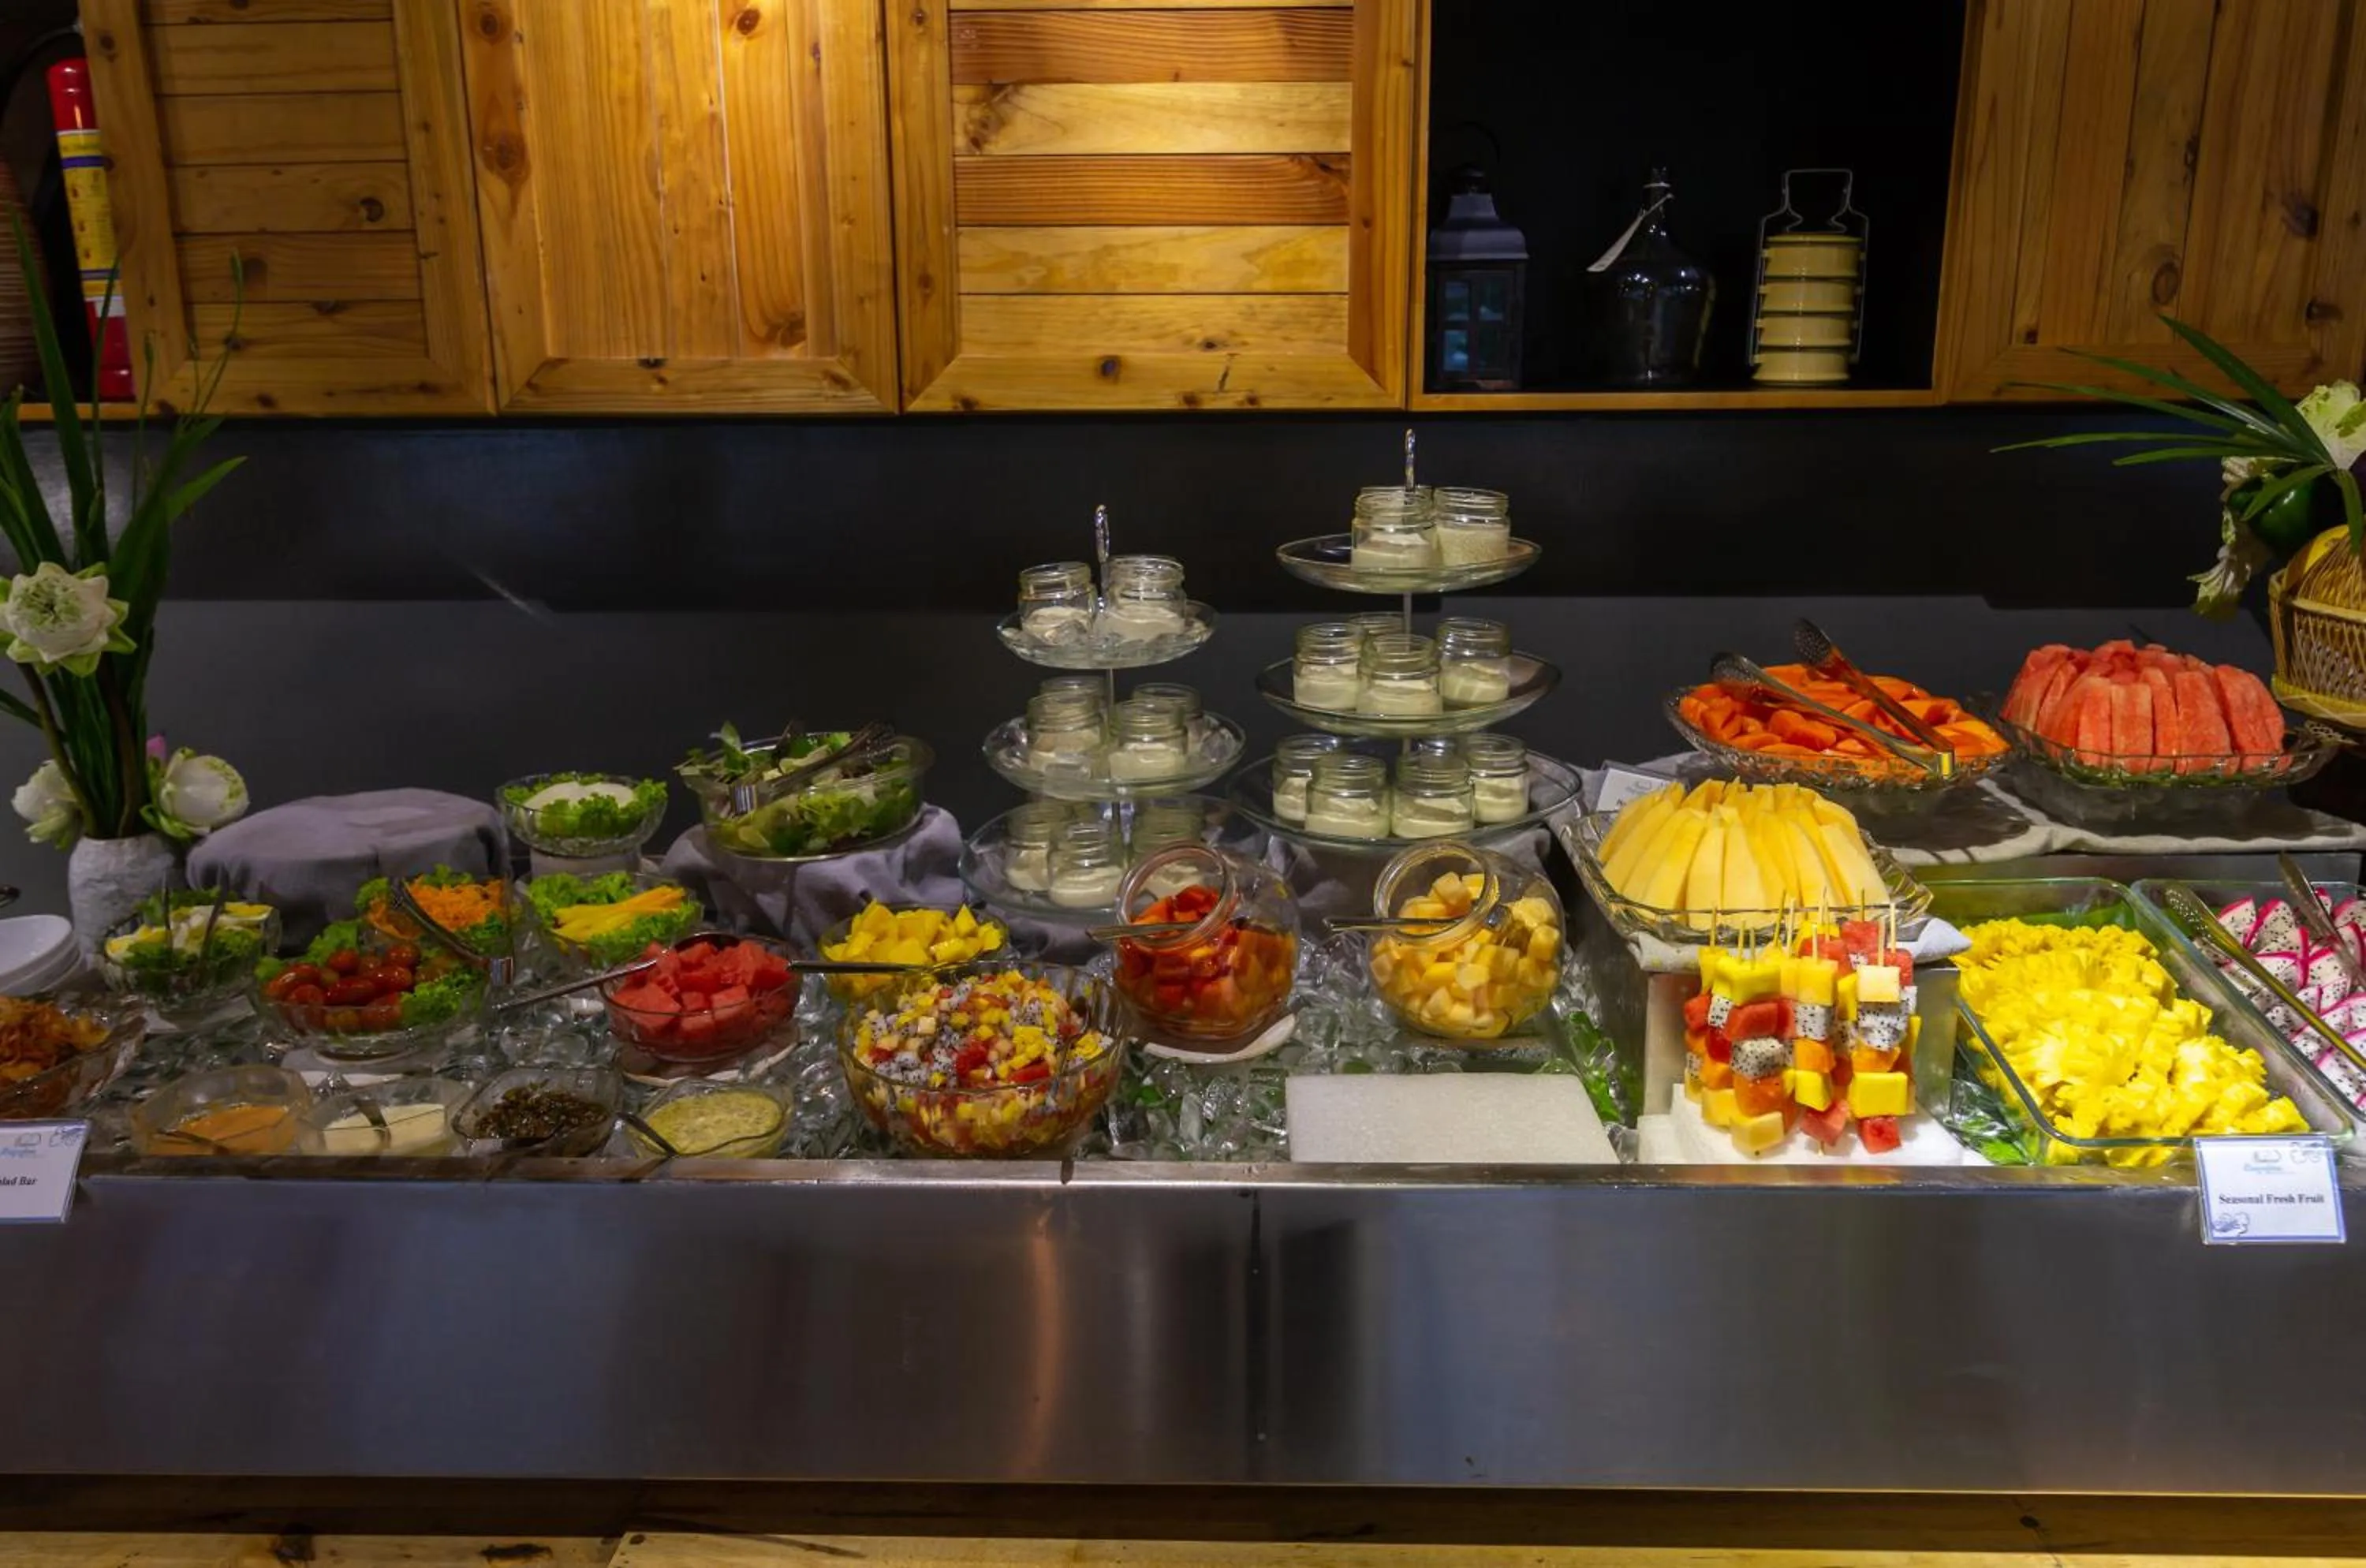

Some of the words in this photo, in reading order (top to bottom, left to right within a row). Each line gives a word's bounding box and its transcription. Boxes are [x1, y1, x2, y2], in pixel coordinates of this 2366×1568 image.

[19, 1176, 38, 1186] Bar
[2219, 1193, 2263, 1204] Seasonal
[2266, 1193, 2295, 1204] Fresh
[2297, 1193, 2325, 1204] Fruit
